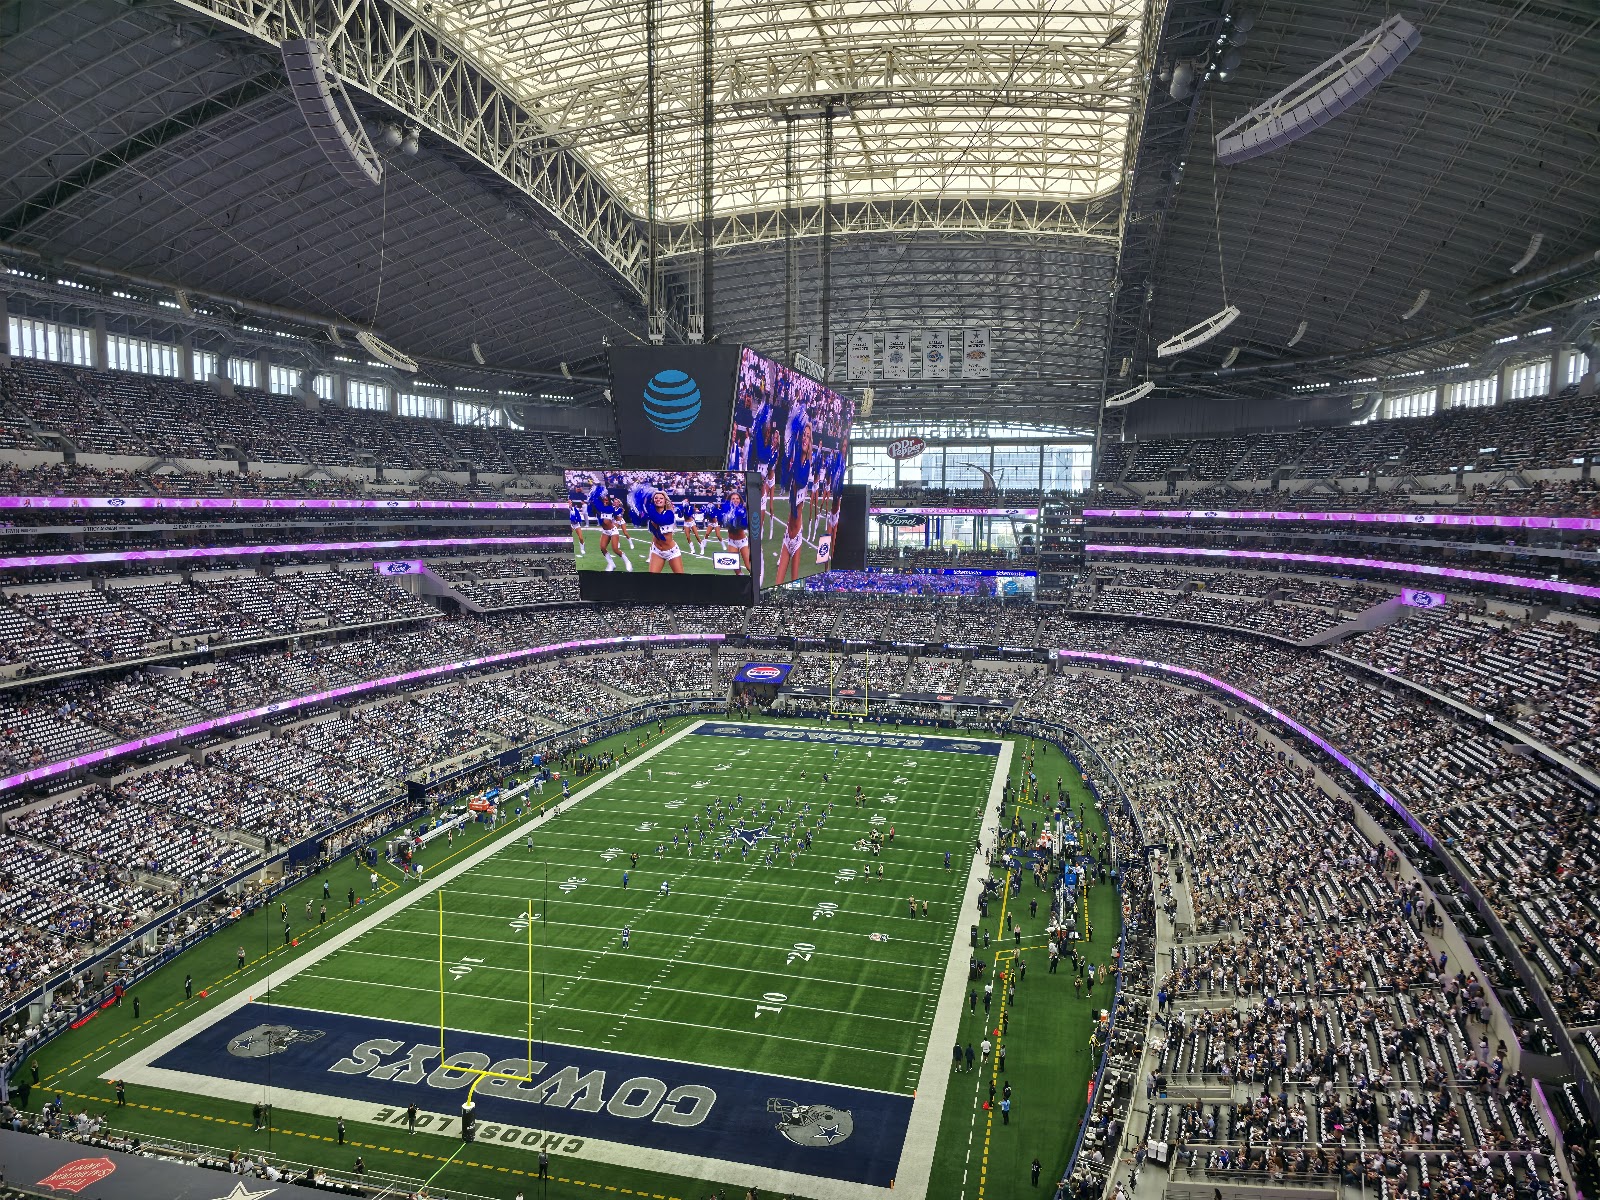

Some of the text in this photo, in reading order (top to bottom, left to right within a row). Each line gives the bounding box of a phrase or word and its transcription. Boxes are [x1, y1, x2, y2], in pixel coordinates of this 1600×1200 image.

[889, 442, 923, 457] Pepper
[901, 440, 915, 448] Dr
[886, 515, 917, 526] Ford
[764, 729, 926, 747] COWBOYS
[787, 942, 816, 962] 20
[756, 992, 788, 1015] 10
[328, 1038, 717, 1127] COWBOYS
